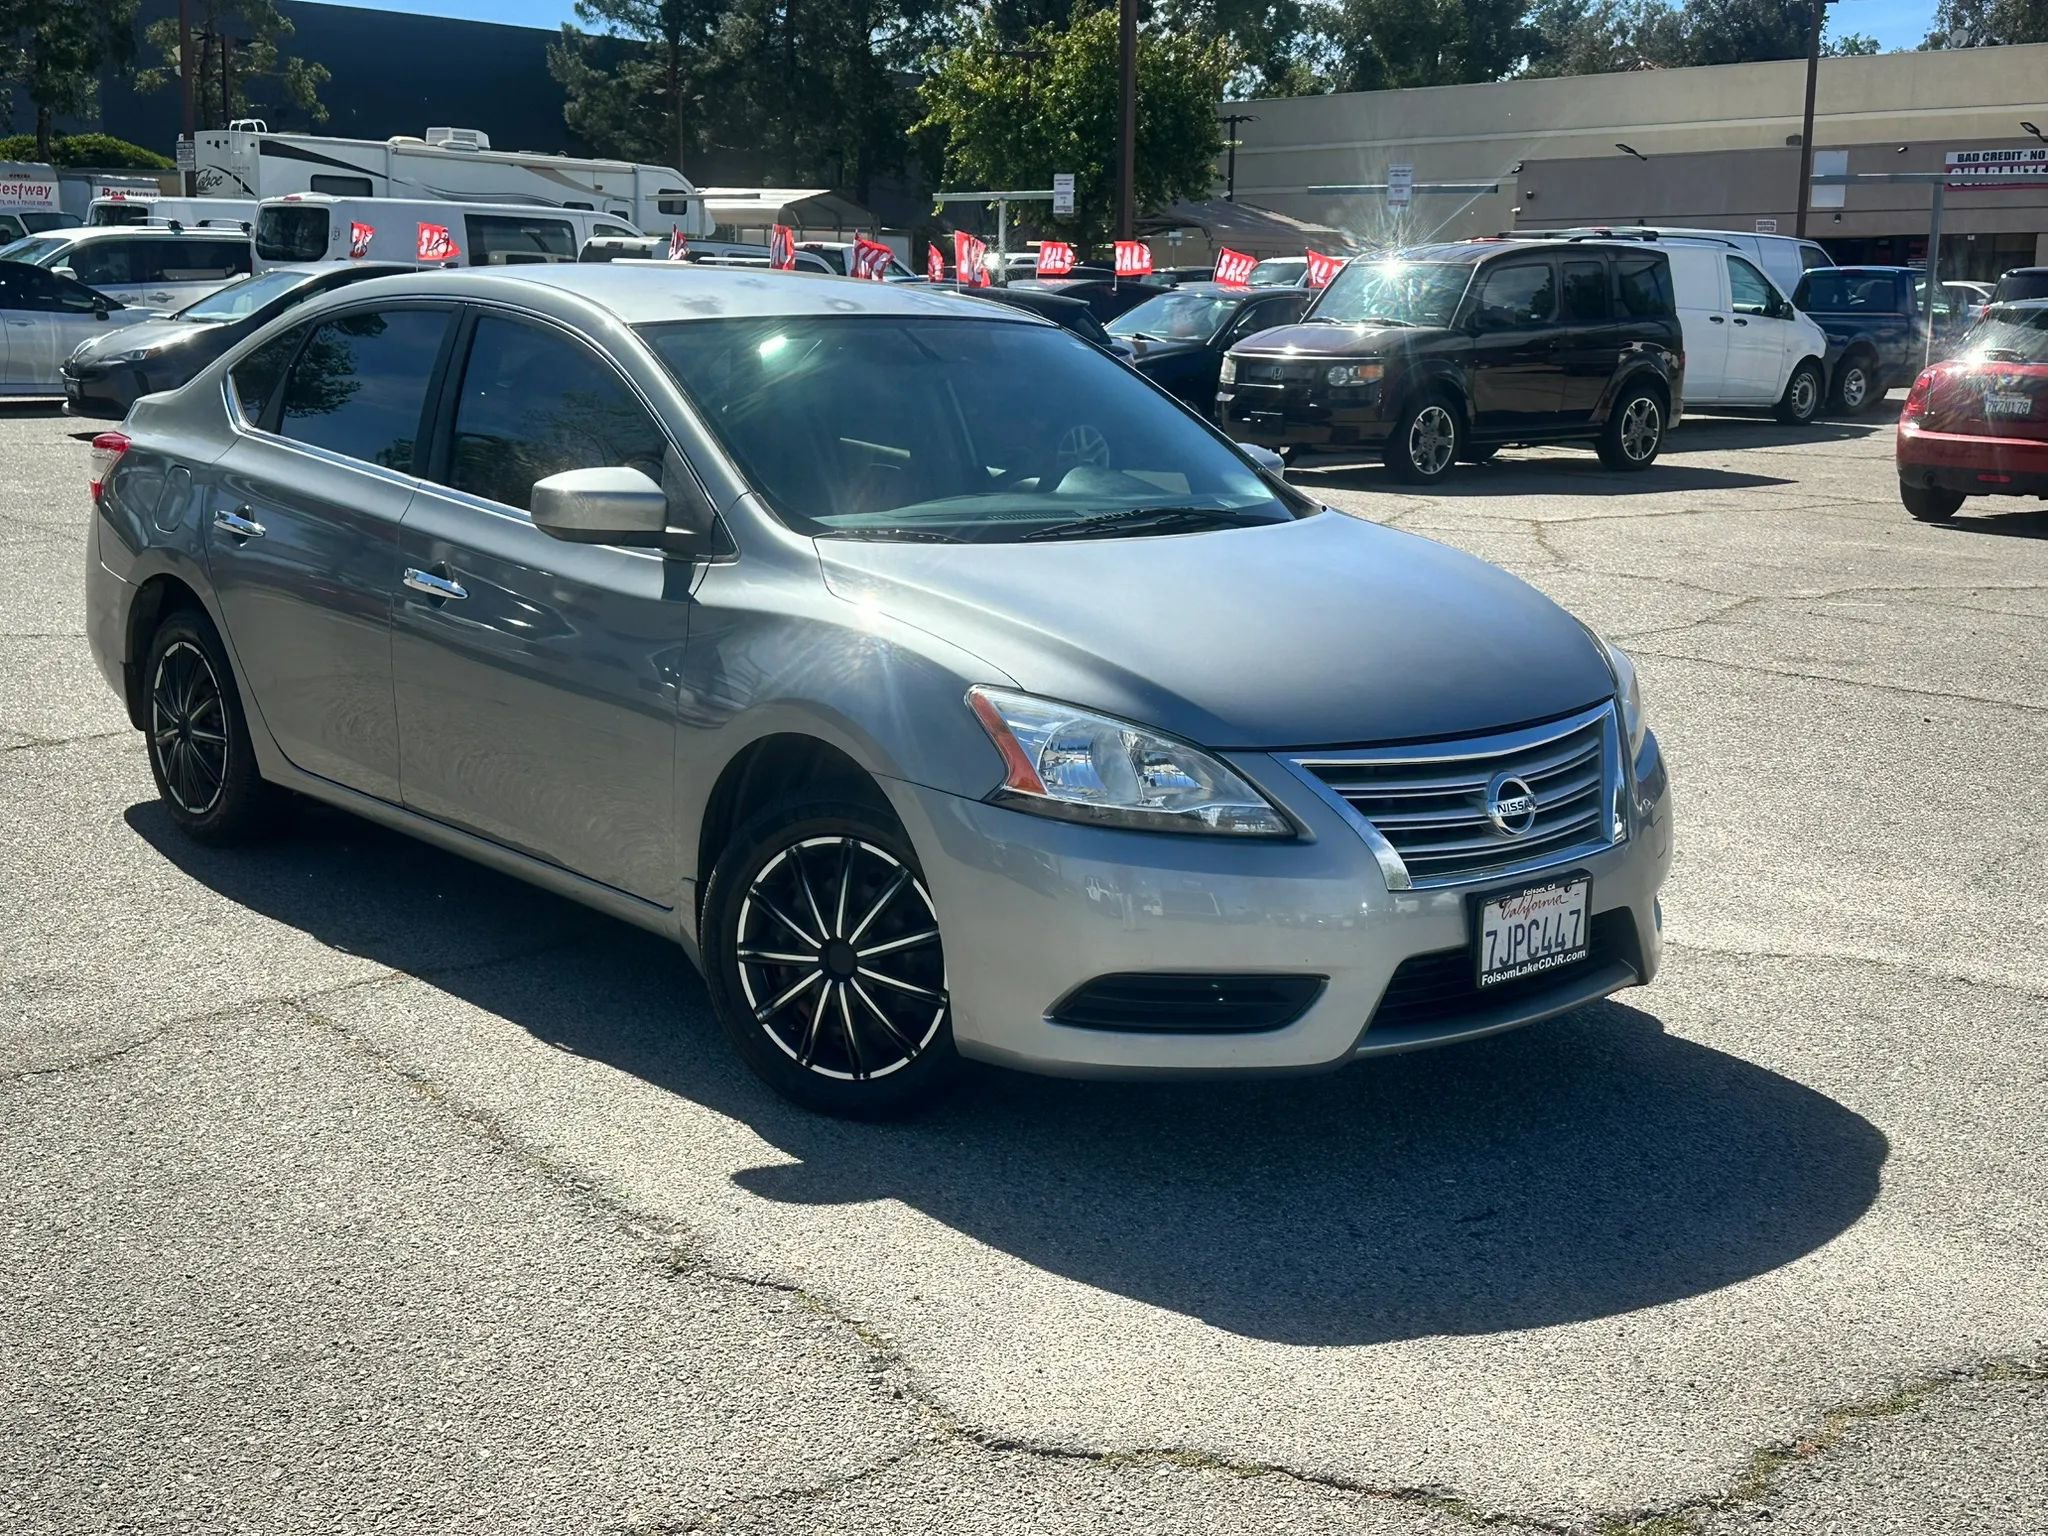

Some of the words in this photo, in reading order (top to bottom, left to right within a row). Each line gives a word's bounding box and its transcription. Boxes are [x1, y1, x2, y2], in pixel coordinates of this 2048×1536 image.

[1957, 153, 1980, 163] BAD
[1982, 151, 2022, 161] CREDIT
[2030, 150, 2046, 160] NO
[1040, 247, 1074, 268] SALE
[1115, 247, 1151, 271] SALE
[1485, 909, 1581, 970] 7JPC447
[1481, 950, 1586, 986] FolsomLakeCDJR.com
